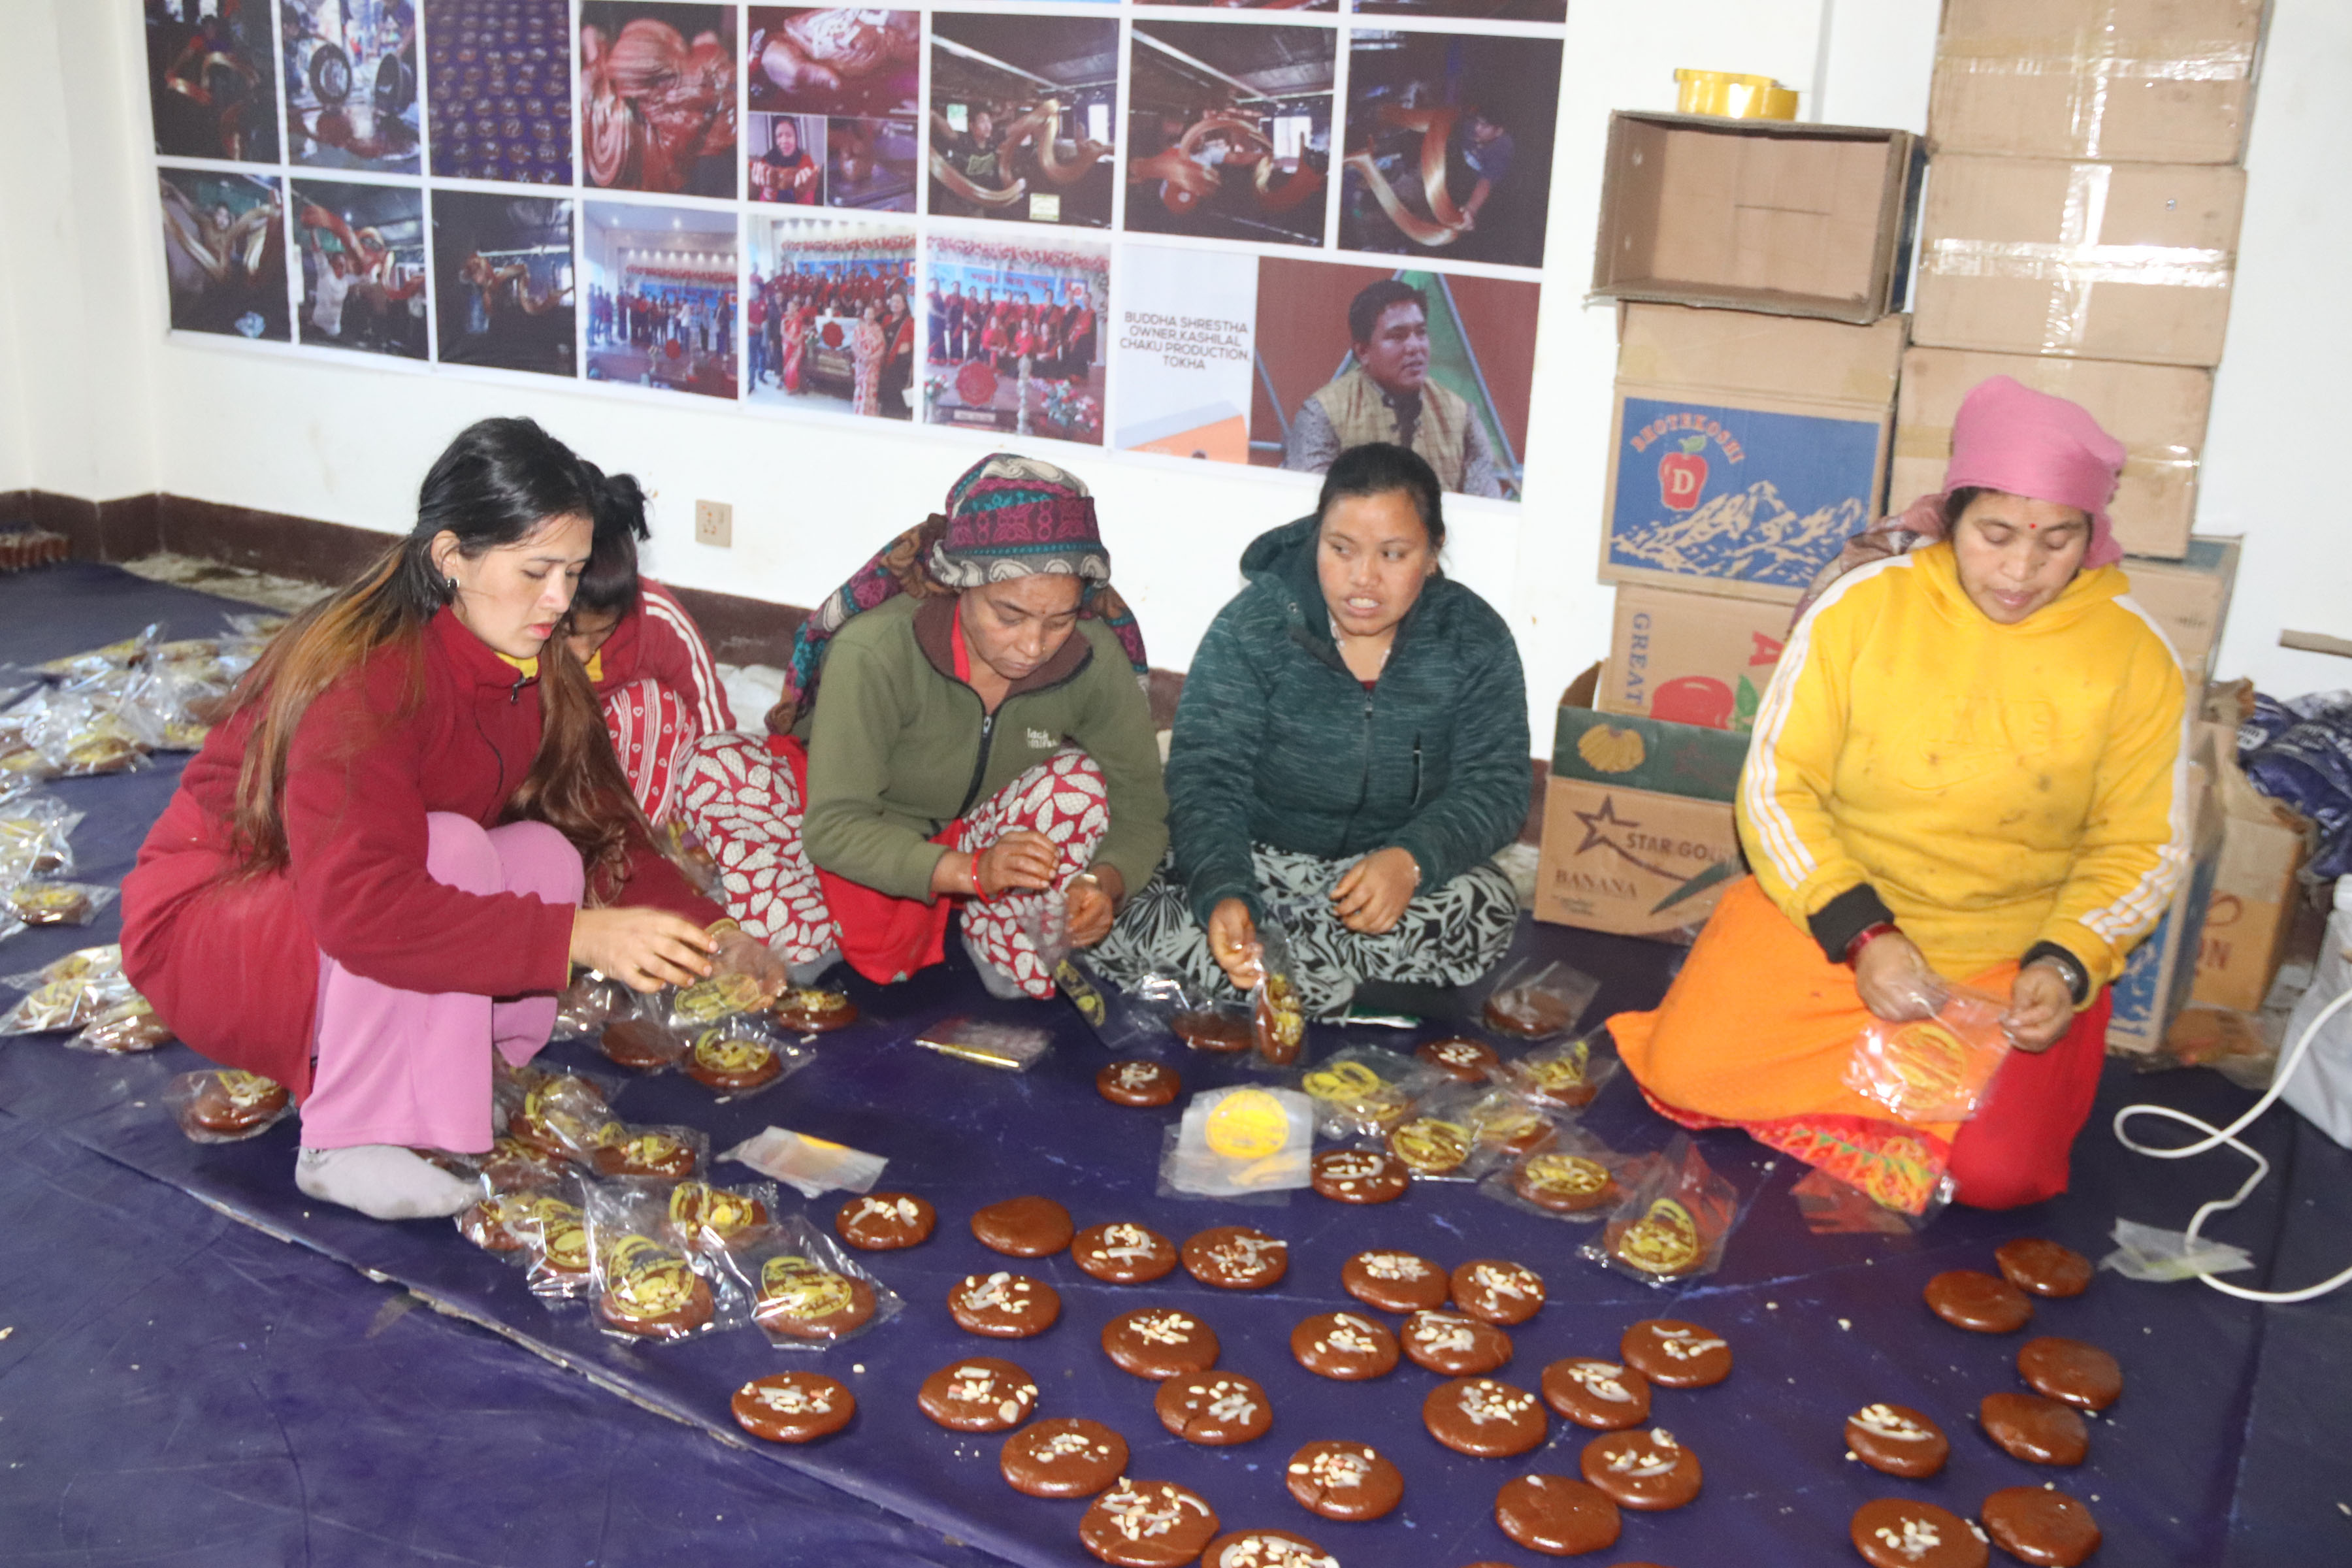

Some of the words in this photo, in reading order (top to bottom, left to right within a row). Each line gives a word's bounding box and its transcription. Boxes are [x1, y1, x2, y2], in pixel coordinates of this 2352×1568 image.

[1124, 311, 1176, 326] BUDDHA
[1180, 316, 1248, 333] SHRESTHA
[1119, 337, 1162, 352] CHAKU
[1162, 355, 1206, 370] TOKHA
[1671, 468, 1695, 495] D
[1625, 612, 1651, 706] GREAT
[1625, 832, 1671, 854] STAR
[1554, 868, 1639, 899] BANANA
